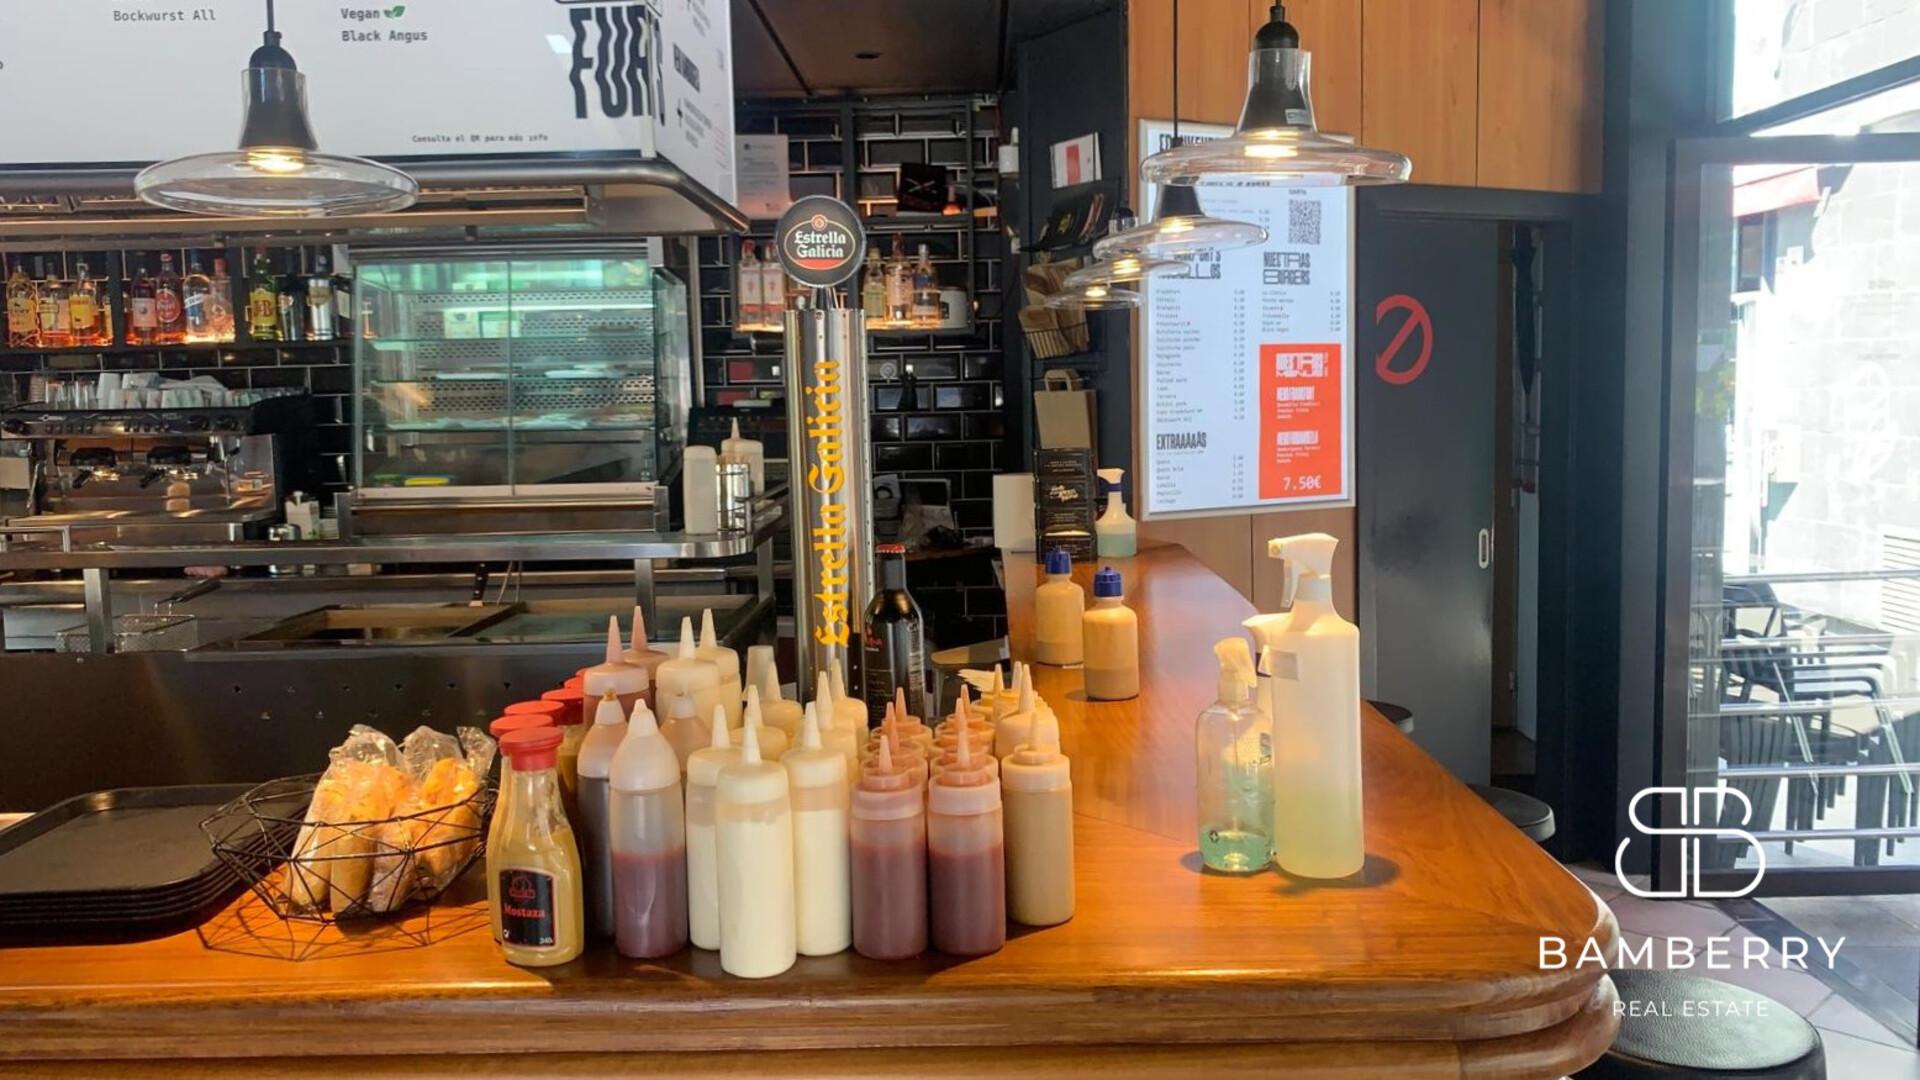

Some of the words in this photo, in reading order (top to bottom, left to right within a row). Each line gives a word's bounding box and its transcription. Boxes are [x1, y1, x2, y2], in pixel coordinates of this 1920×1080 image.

[113, 9, 184, 21] Bockwurst
[193, 8, 217, 21] All
[340, 8, 380, 21] Vegan
[342, 30, 381, 42] Black
[389, 30, 429, 43] Angus
[412, 134, 451, 143] Consulta
[455, 134, 465, 142] el
[485, 135, 504, 143] para
[529, 133, 549, 141] info
[794, 230, 847, 244] Estrella
[796, 243, 844, 258] Galicia
[805, 359, 845, 495] Galicia
[1282, 474, 1322, 491] 7.50€
[811, 502, 850, 649] Estrella
[503, 903, 546, 918] Mostaza
